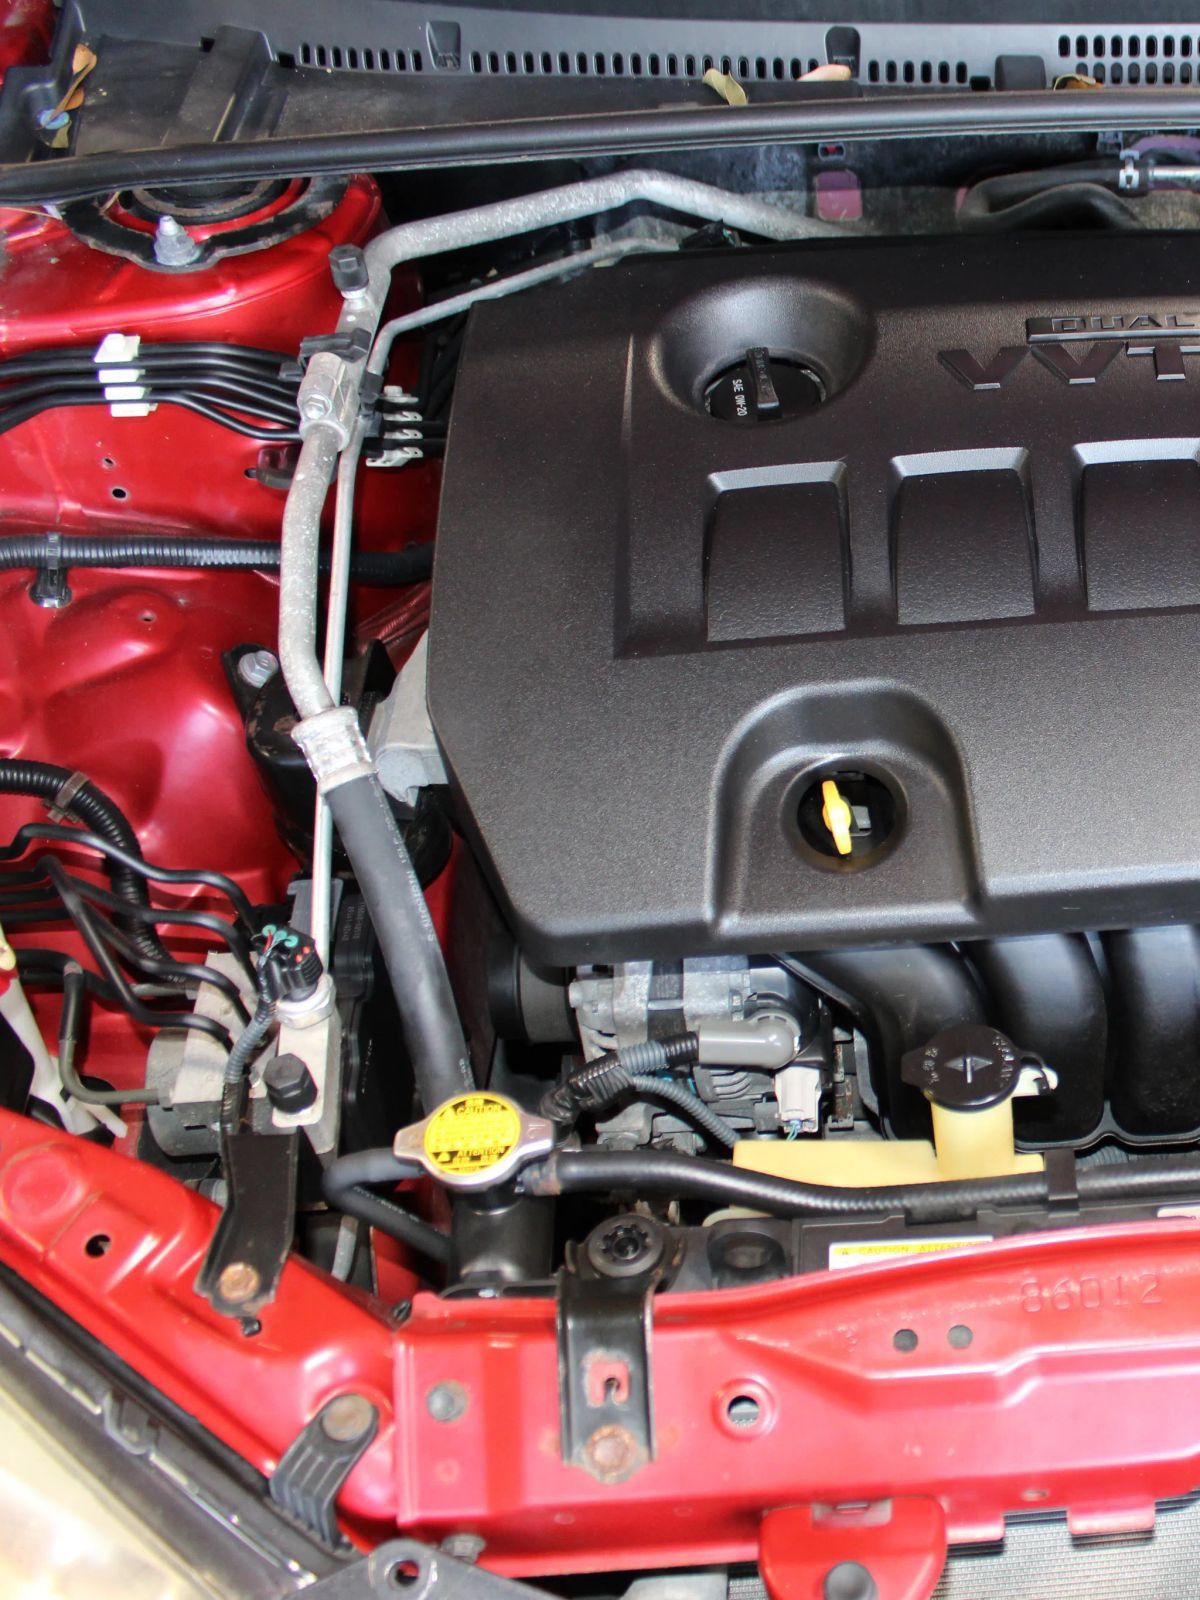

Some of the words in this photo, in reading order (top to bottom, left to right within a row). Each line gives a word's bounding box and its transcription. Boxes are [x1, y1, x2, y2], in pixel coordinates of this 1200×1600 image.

[1050, 313, 1197, 331] DUAL
[732, 378, 744, 393] SAE
[734, 394, 748, 417] 0W-20
[456, 1105, 502, 1115] CAUTION
[456, 1146, 505, 1157] ATTENTION
[1021, 1273, 1163, 1312] 86012
